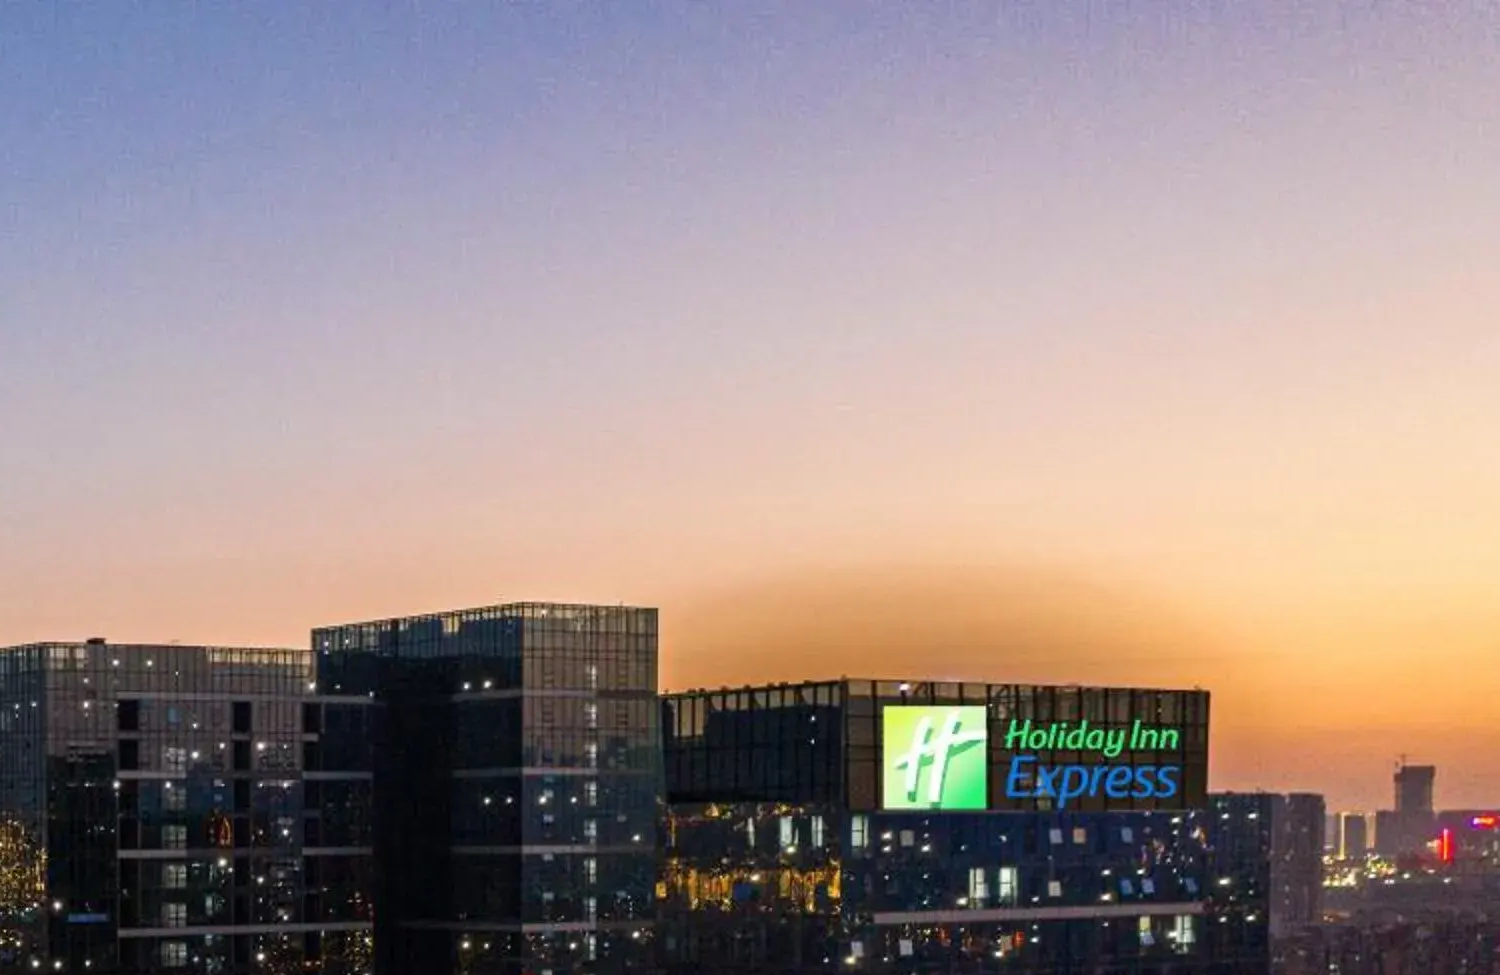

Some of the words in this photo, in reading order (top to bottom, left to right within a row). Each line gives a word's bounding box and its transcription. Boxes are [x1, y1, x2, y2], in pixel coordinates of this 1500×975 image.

[1004, 719, 1125, 757] Holiday
[1129, 721, 1180, 750] Inn
[1005, 754, 1180, 809] Express
